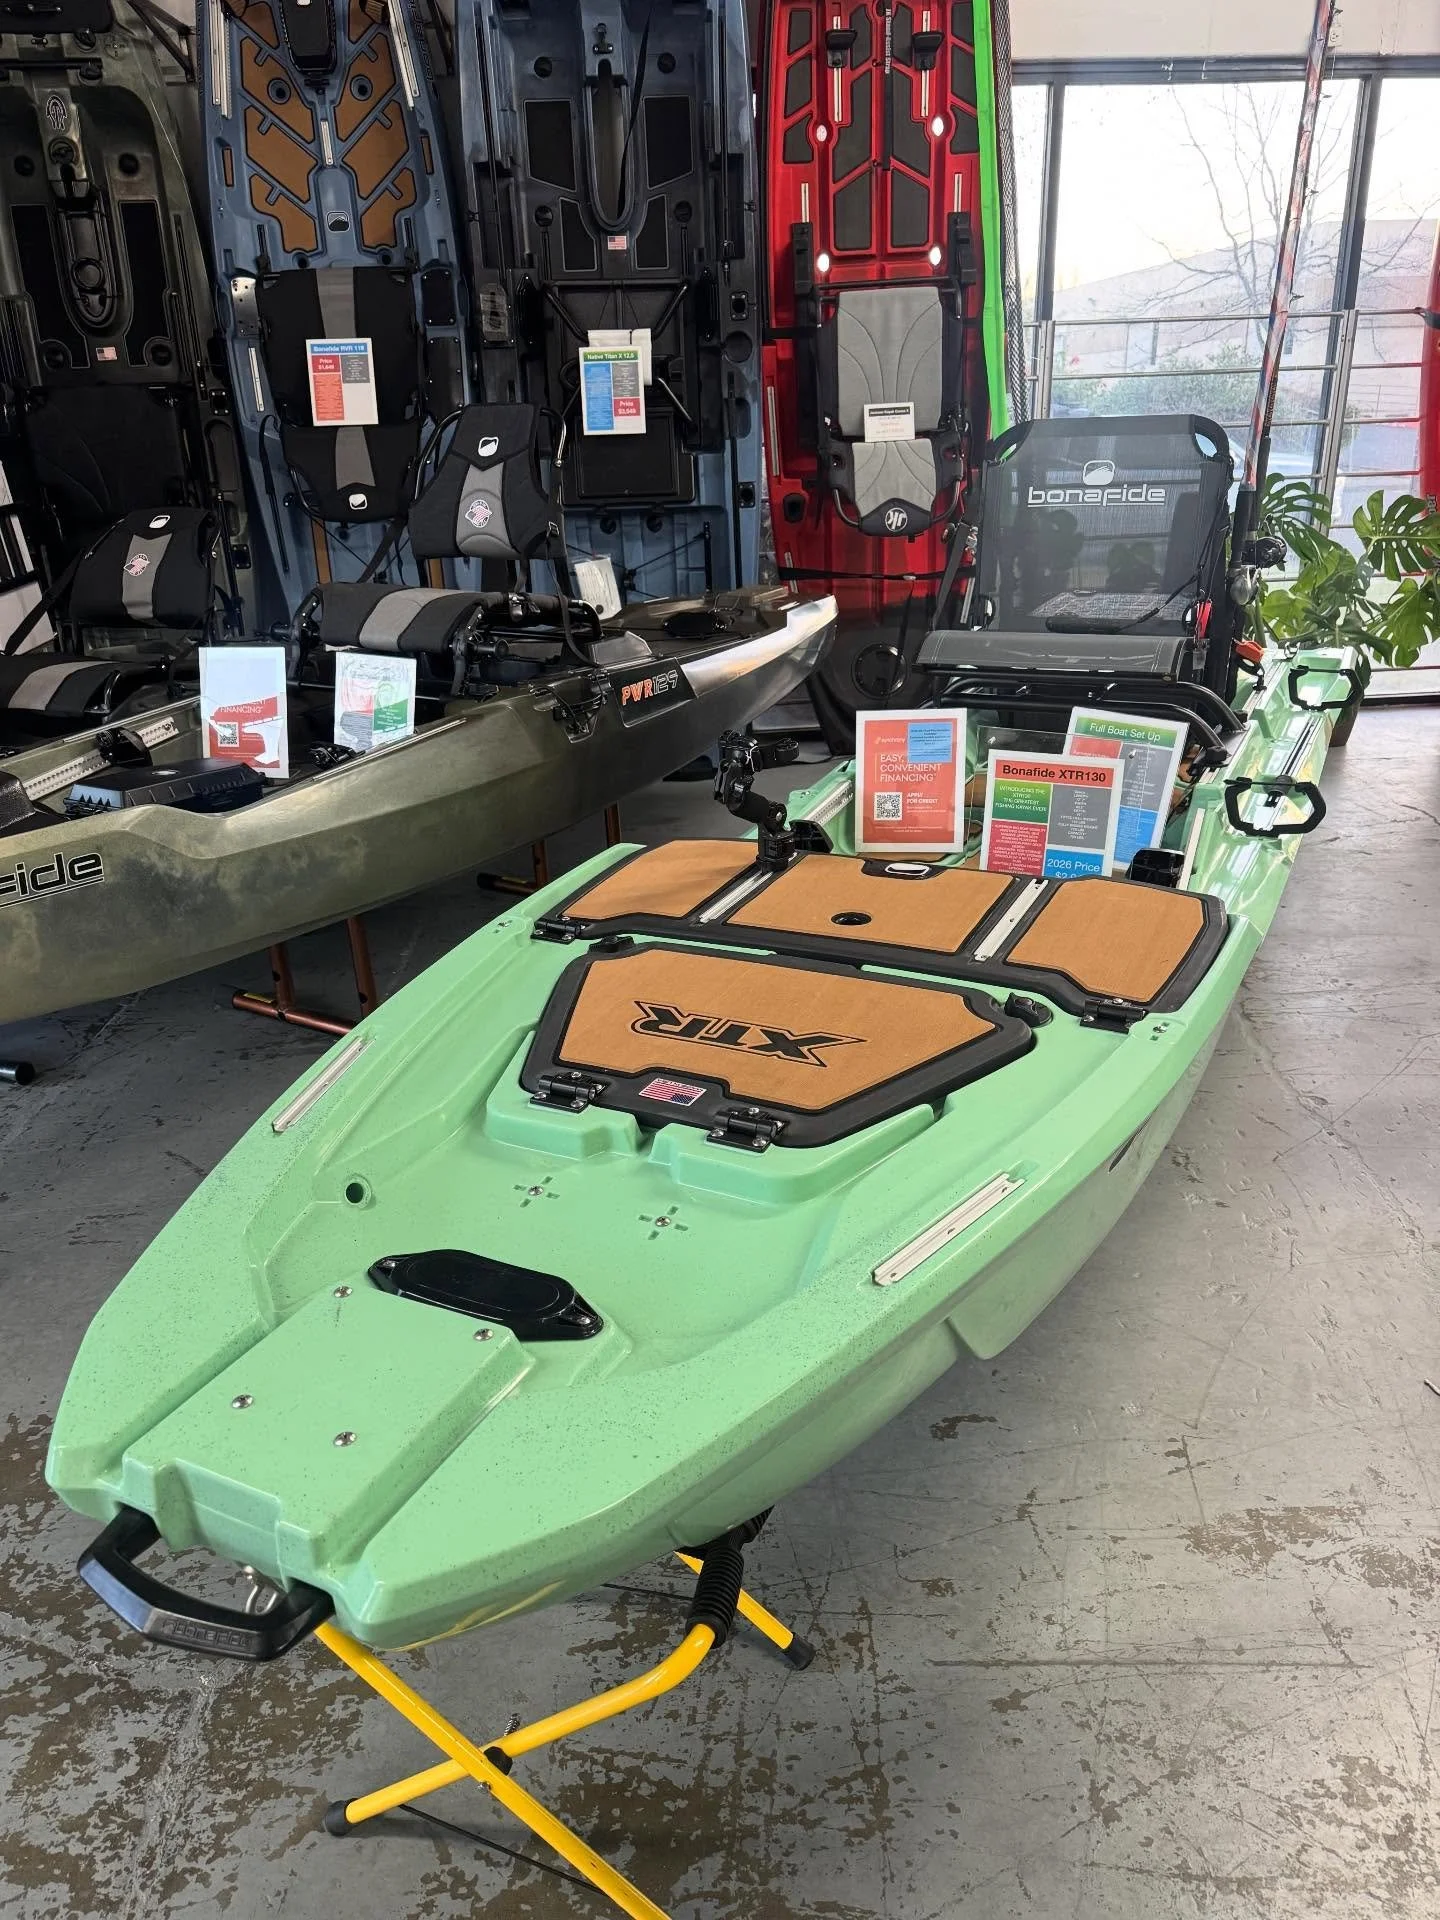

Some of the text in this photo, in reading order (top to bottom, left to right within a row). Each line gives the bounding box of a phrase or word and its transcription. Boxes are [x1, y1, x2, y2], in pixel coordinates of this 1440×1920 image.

[1028, 484, 1166, 507] bonafide
[621, 669, 679, 706] PWR129
[1089, 722, 1161, 743] Full Boat Set Up
[880, 754, 905, 763] EASY,
[880, 763, 942, 773] CONVENIENT
[1002, 764, 1106, 782] Bonafide XTR130
[1047, 858, 1100, 872] 2026 Price
[631, 1001, 867, 1066] XTR
